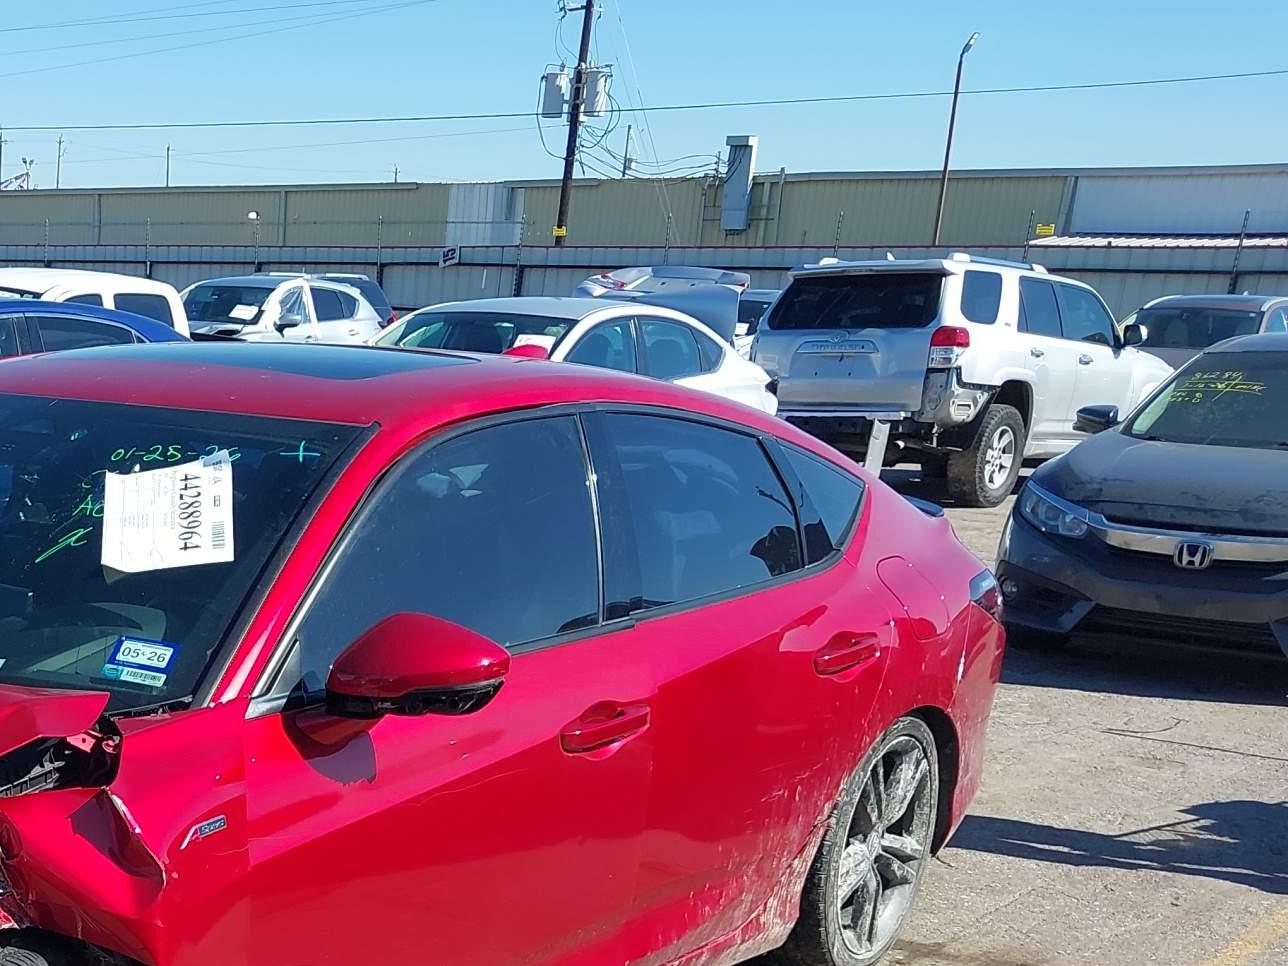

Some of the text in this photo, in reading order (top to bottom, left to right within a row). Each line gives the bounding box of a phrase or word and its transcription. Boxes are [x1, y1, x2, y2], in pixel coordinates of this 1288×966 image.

[442, 248, 456, 265] 15
[178, 473, 202, 551] 44288964
[121, 646, 142, 659] 05
[146, 651, 168, 663] 26
